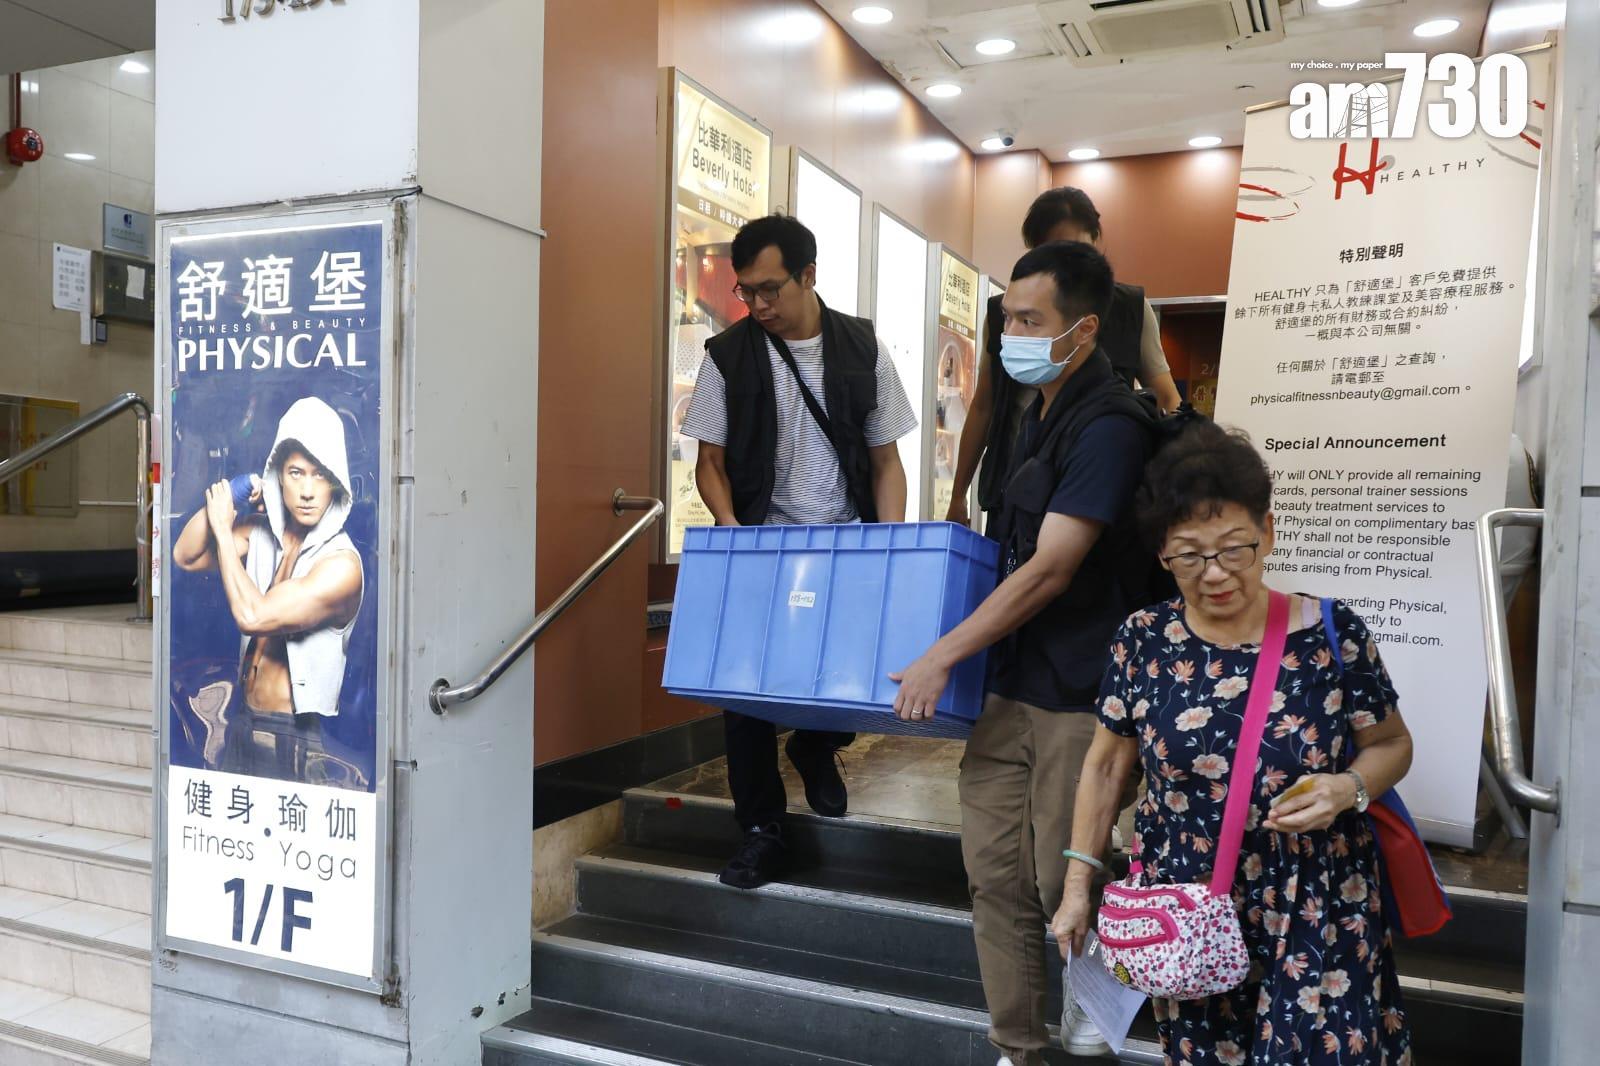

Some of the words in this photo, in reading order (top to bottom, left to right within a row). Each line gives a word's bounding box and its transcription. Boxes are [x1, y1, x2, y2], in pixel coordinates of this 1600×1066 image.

[698, 118, 753, 172] 比華利酒店
[692, 147, 730, 188] Beverly
[1380, 157, 1486, 183] HEALTHY
[1339, 243, 1404, 264] 特別聲明
[176, 250, 367, 322] 舒適堡
[1254, 287, 1312, 302] HEALTHY
[178, 323, 251, 335] FITNESS
[292, 318, 366, 329] BEAUTY
[178, 332, 367, 372] PHYSICAL
[1331, 371, 1385, 385] 請電郵至
[1264, 437, 1320, 453] Special
[1324, 434, 1446, 449] Announcement
[1287, 470, 1305, 480] will
[1308, 469, 1344, 480] ONLY
[1348, 469, 1393, 482] provide
[1397, 469, 1411, 480] all
[1415, 468, 1482, 483] remaining
[1273, 485, 1307, 498] cards,
[1311, 485, 1363, 498] personal
[1366, 486, 1407, 497] trainer
[1410, 486, 1468, 497] sessions
[1274, 500, 1311, 513] beauty
[1315, 501, 1373, 512] treatment
[1376, 501, 1428, 513] services
[1433, 502, 1445, 513] to
[1284, 515, 1331, 529] Physical
[1335, 518, 1350, 527] on
[1354, 517, 1447, 532] complimentary
[1451, 519, 1475, 530] bas
[1304, 532, 1331, 542] shall
[1335, 533, 1353, 543] not
[1357, 533, 1372, 544] be
[1376, 533, 1450, 547] responsible
[1272, 548, 1293, 559] any
[1295, 547, 1344, 558] financial
[1347, 550, 1361, 559] or
[1363, 550, 1433, 562] contractual
[1263, 561, 1298, 573] sputes
[1301, 563, 1340, 576] arising
[1344, 563, 1371, 576] from
[1375, 565, 1432, 580] Physical.
[1341, 597, 1385, 612] arding
[1389, 598, 1447, 614] Physical,
[1359, 614, 1386, 627] ectly
[1390, 616, 1402, 626] to
[183, 826, 254, 861] Fitness
[280, 841, 356, 881] Yoga
[223, 877, 314, 952] 1/F
